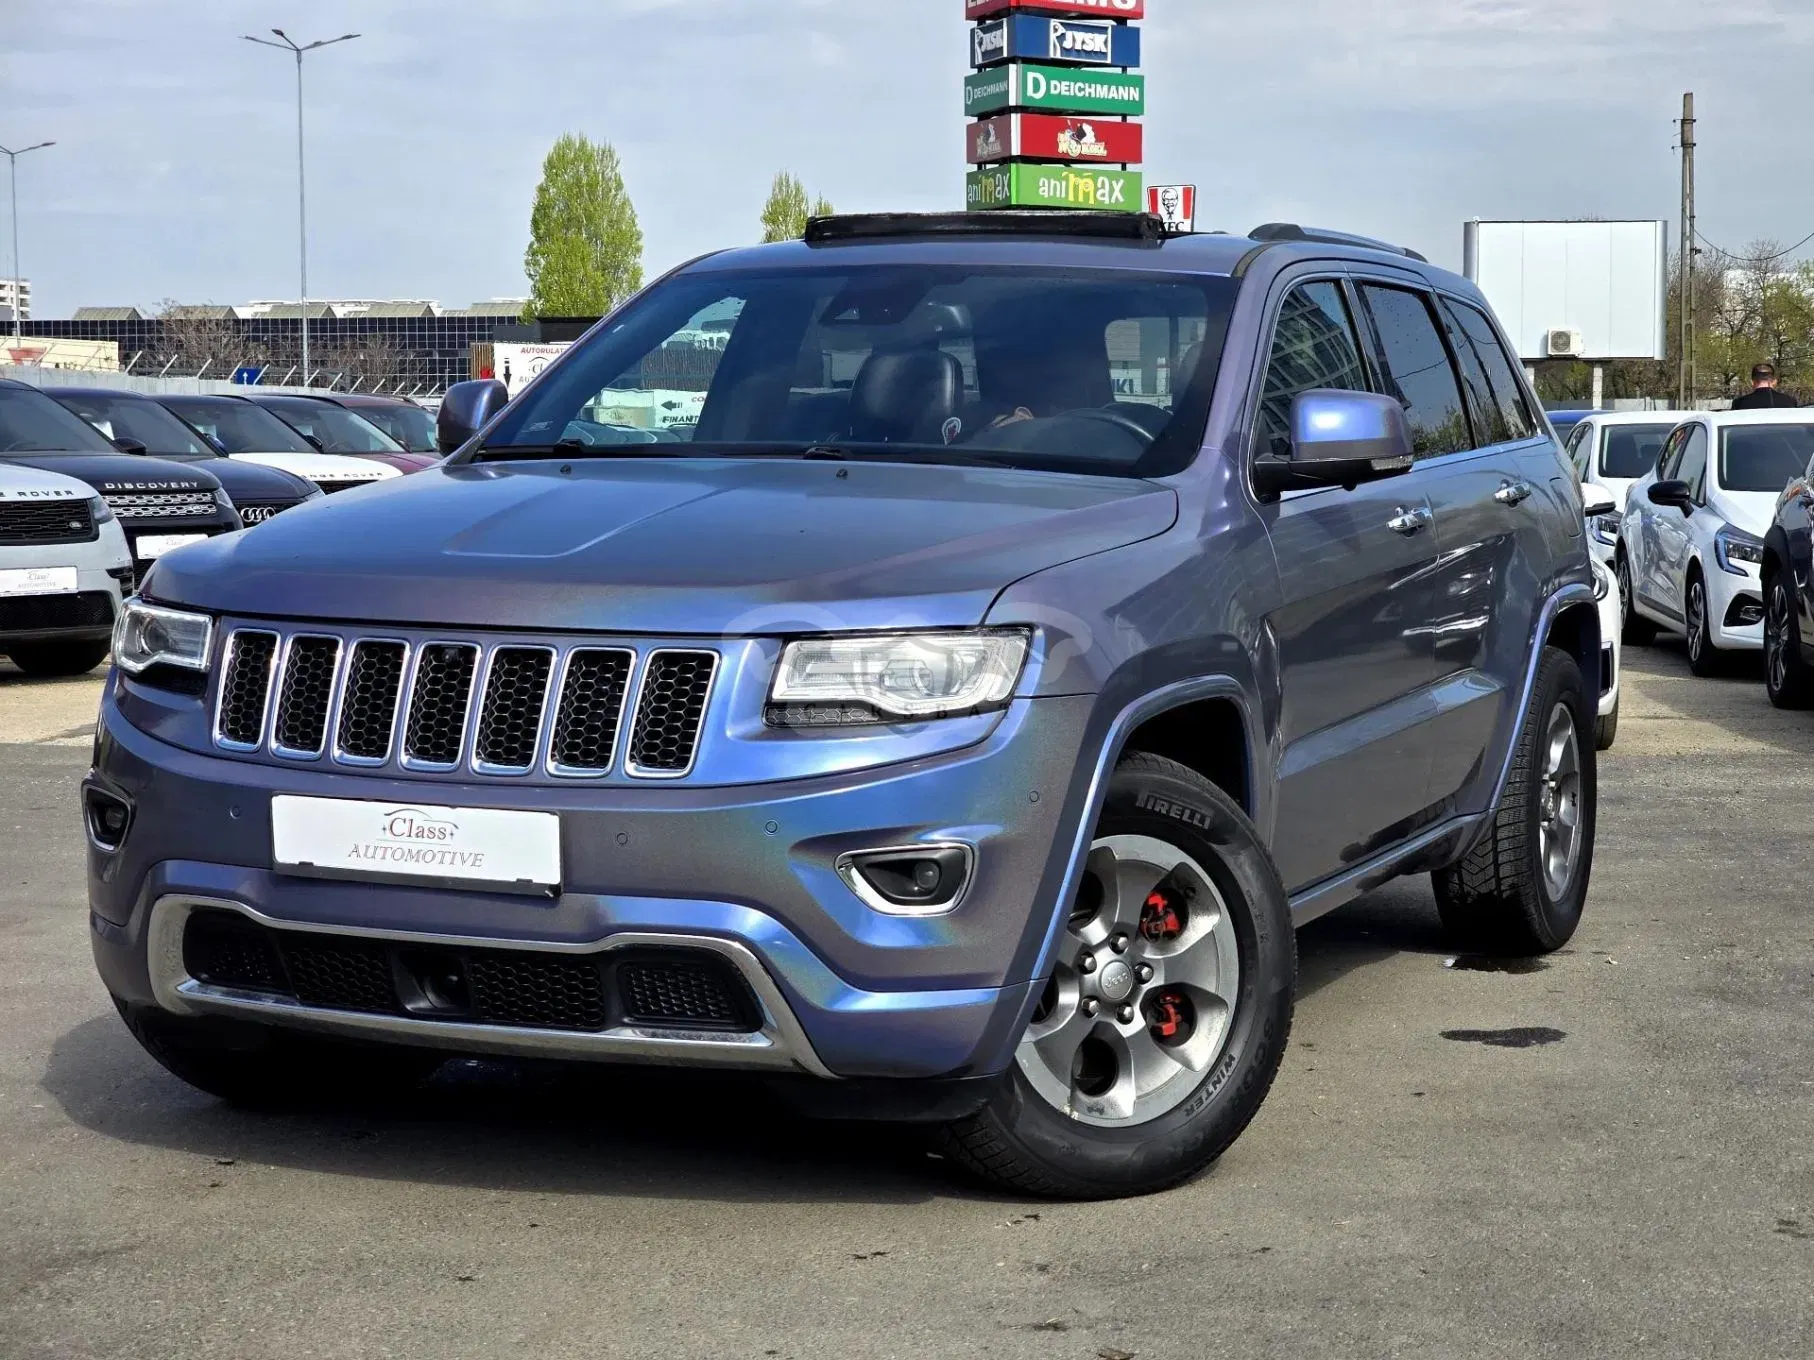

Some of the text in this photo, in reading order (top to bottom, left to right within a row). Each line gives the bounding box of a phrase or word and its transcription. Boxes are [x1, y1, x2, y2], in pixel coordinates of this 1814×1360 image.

[1063, 31, 1109, 53] JYSK
[974, 80, 1008, 99] DEICHMANN
[1050, 80, 1140, 102] DEICHMANN
[1039, 171, 1125, 205] animax
[520, 346, 568, 355] AUTORULAT
[661, 415, 701, 424] FINANT
[17, 490, 75, 498] ROVER
[104, 481, 199, 490] DISCOVERY
[1136, 788, 1215, 830] PIRELLI
[389, 817, 448, 841] Class
[348, 843, 487, 869] AUTOMOTIVE
[1183, 1053, 1236, 1117] WINTER
